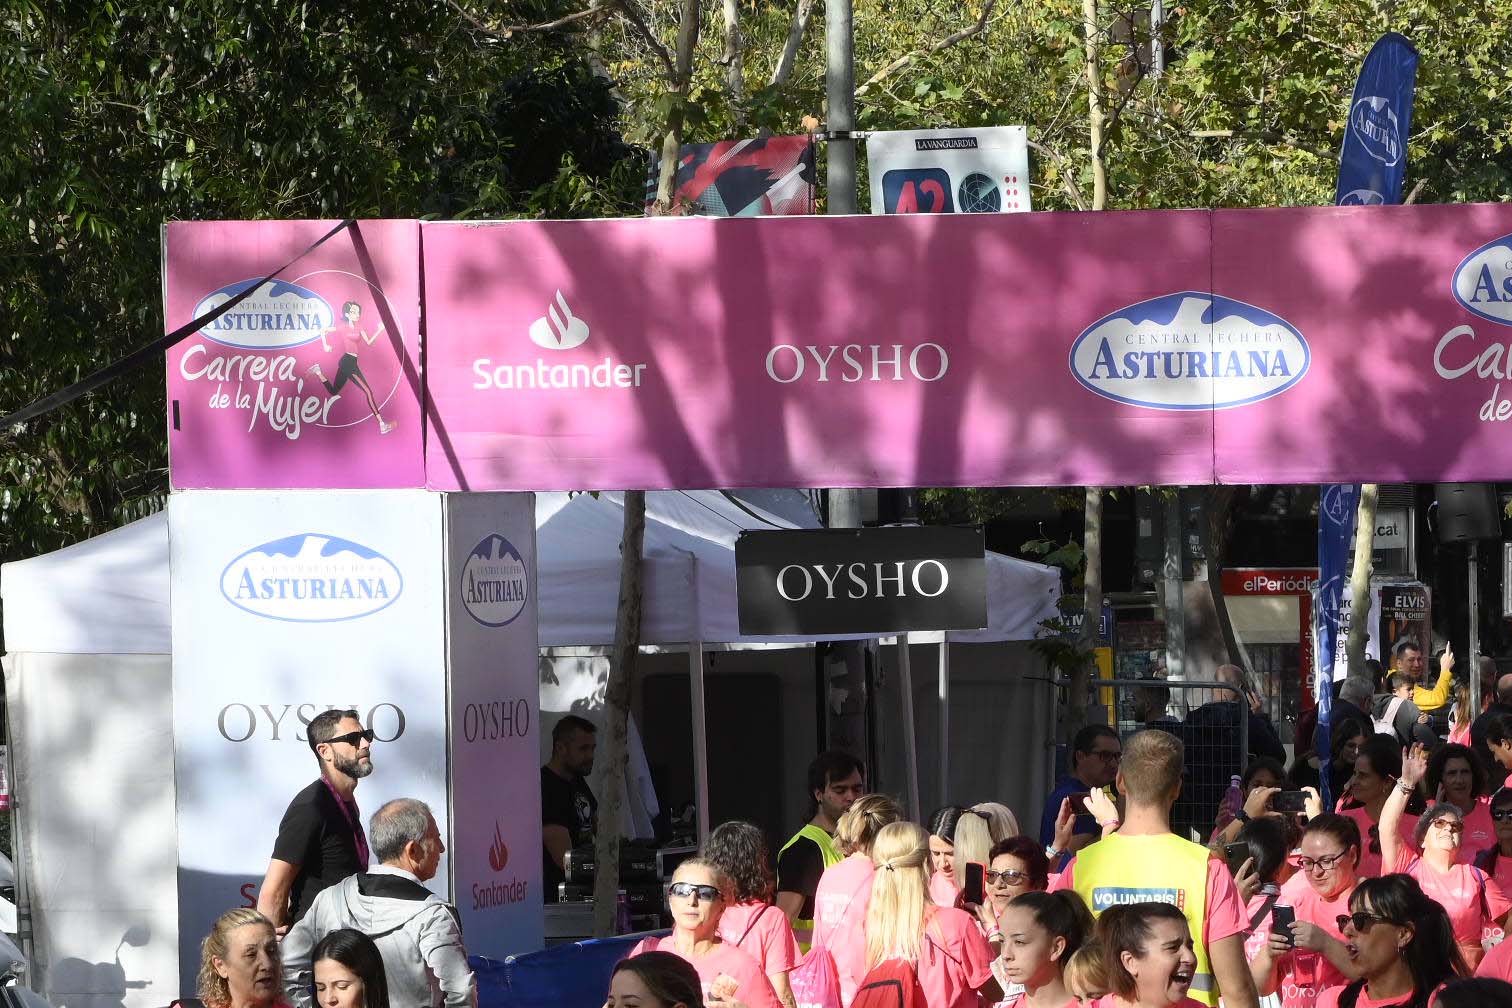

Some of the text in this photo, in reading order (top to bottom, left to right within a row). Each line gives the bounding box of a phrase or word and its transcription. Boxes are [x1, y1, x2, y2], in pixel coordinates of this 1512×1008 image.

[927, 138, 977, 149] VANGUARDIA
[1124, 332, 1284, 345] CENTRAL LECHERA
[179, 344, 297, 382] Carrera
[472, 358, 647, 390] Santander
[765, 341, 950, 383] OYSHO
[1087, 336, 1291, 381] ASTURIANA
[209, 377, 342, 440] de la Mujer
[234, 566, 390, 600] ASTURIANA
[466, 568, 525, 604] ASTURIANA
[775, 559, 950, 602] OYSHO
[1394, 595, 1425, 608] ELVIS
[217, 702, 407, 743] OYSO
[463, 698, 530, 744] OYSHO
[471, 878, 528, 912] Santander
[1093, 892, 1176, 906] VOLUNTARIS
